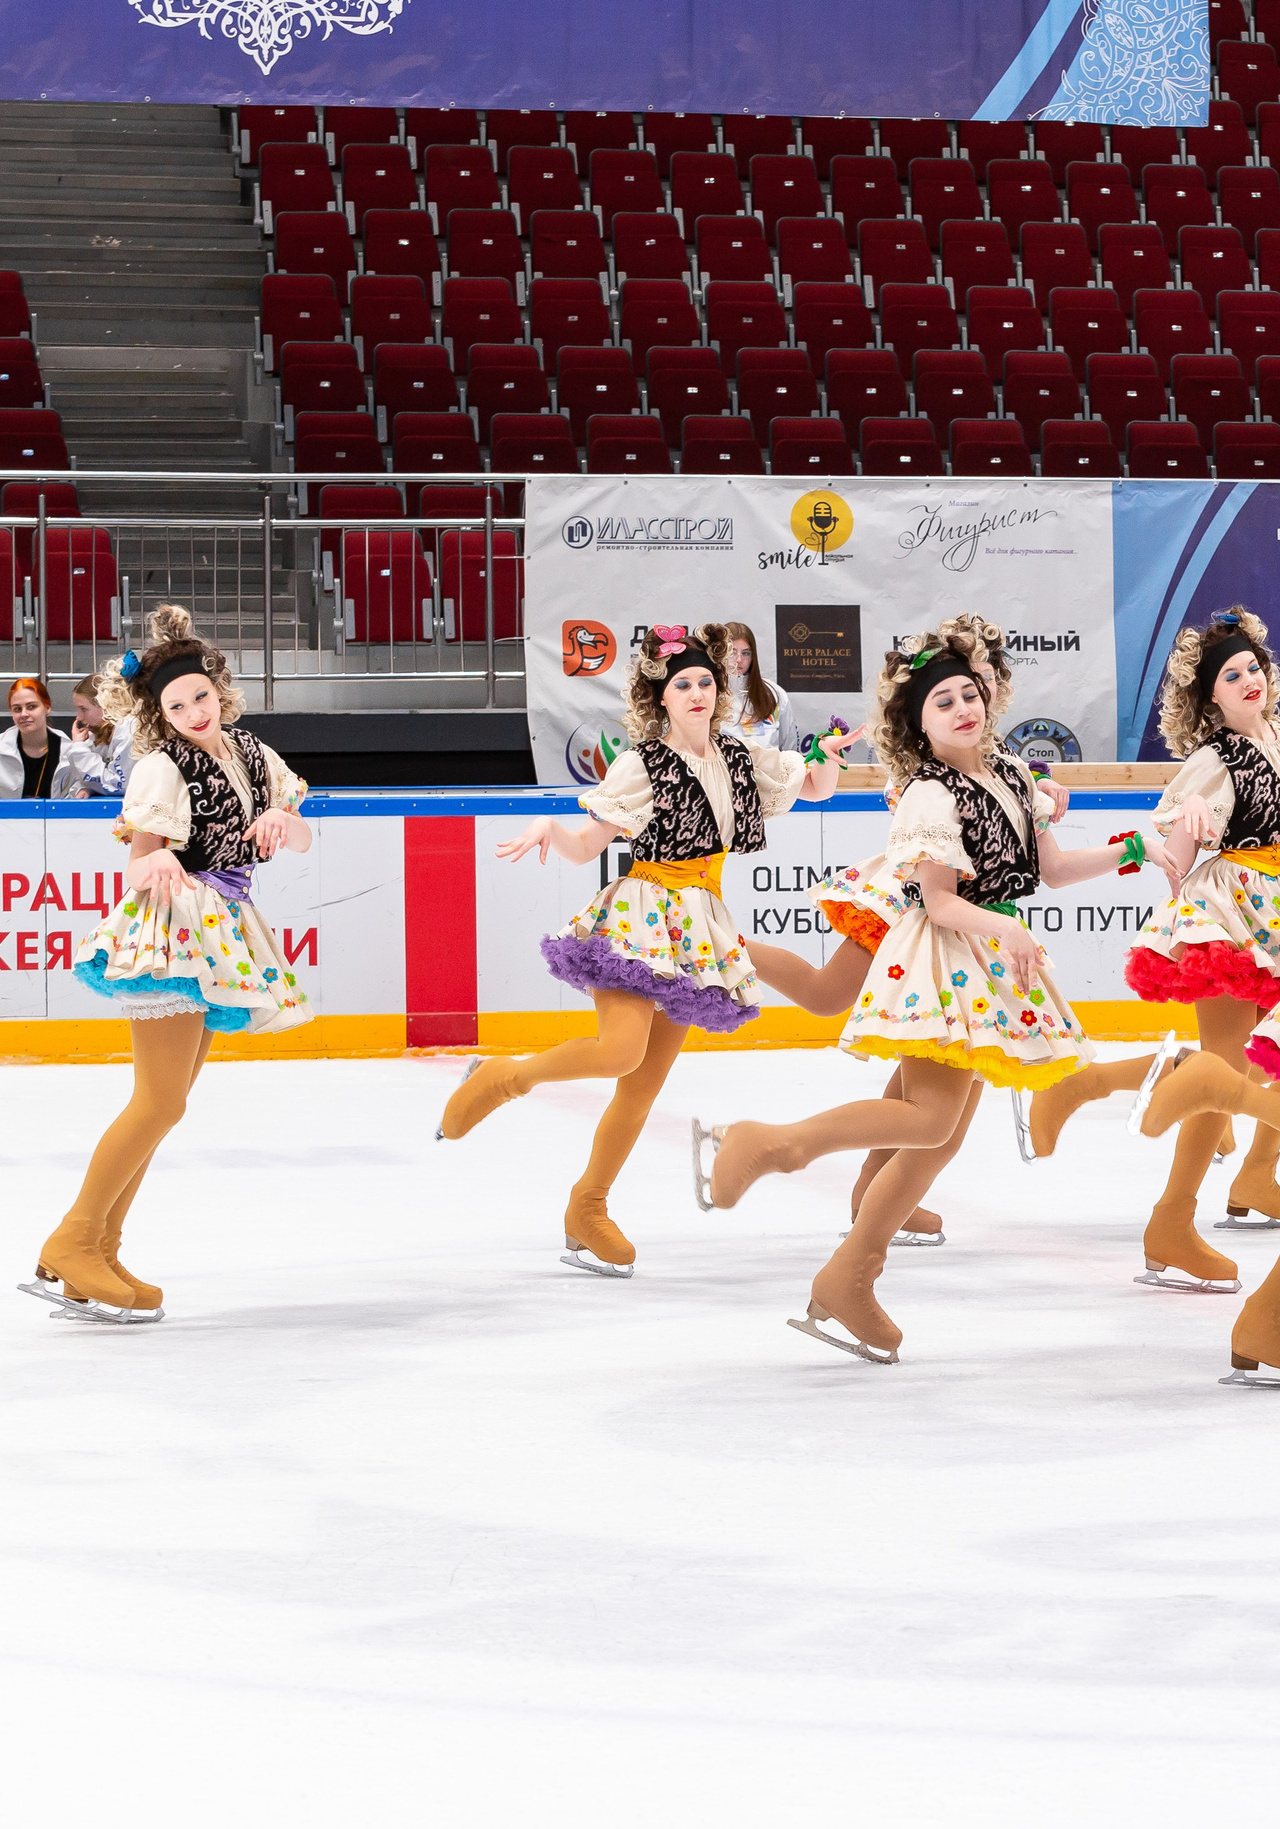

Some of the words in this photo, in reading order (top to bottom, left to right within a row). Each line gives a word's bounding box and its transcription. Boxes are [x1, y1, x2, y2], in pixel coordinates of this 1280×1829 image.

[596, 517, 734, 540] ИЛАССТРОЙ
[893, 504, 1059, 572] Фигурист
[758, 543, 819, 570] smile
[783, 648, 813, 657] RIVER
[815, 648, 852, 657] PALACE
[802, 658, 837, 666] HOTEL
[1027, 747, 1054, 758] Стоп
[752, 866, 850, 893] OLIM
[753, 908, 832, 935] КУБО
